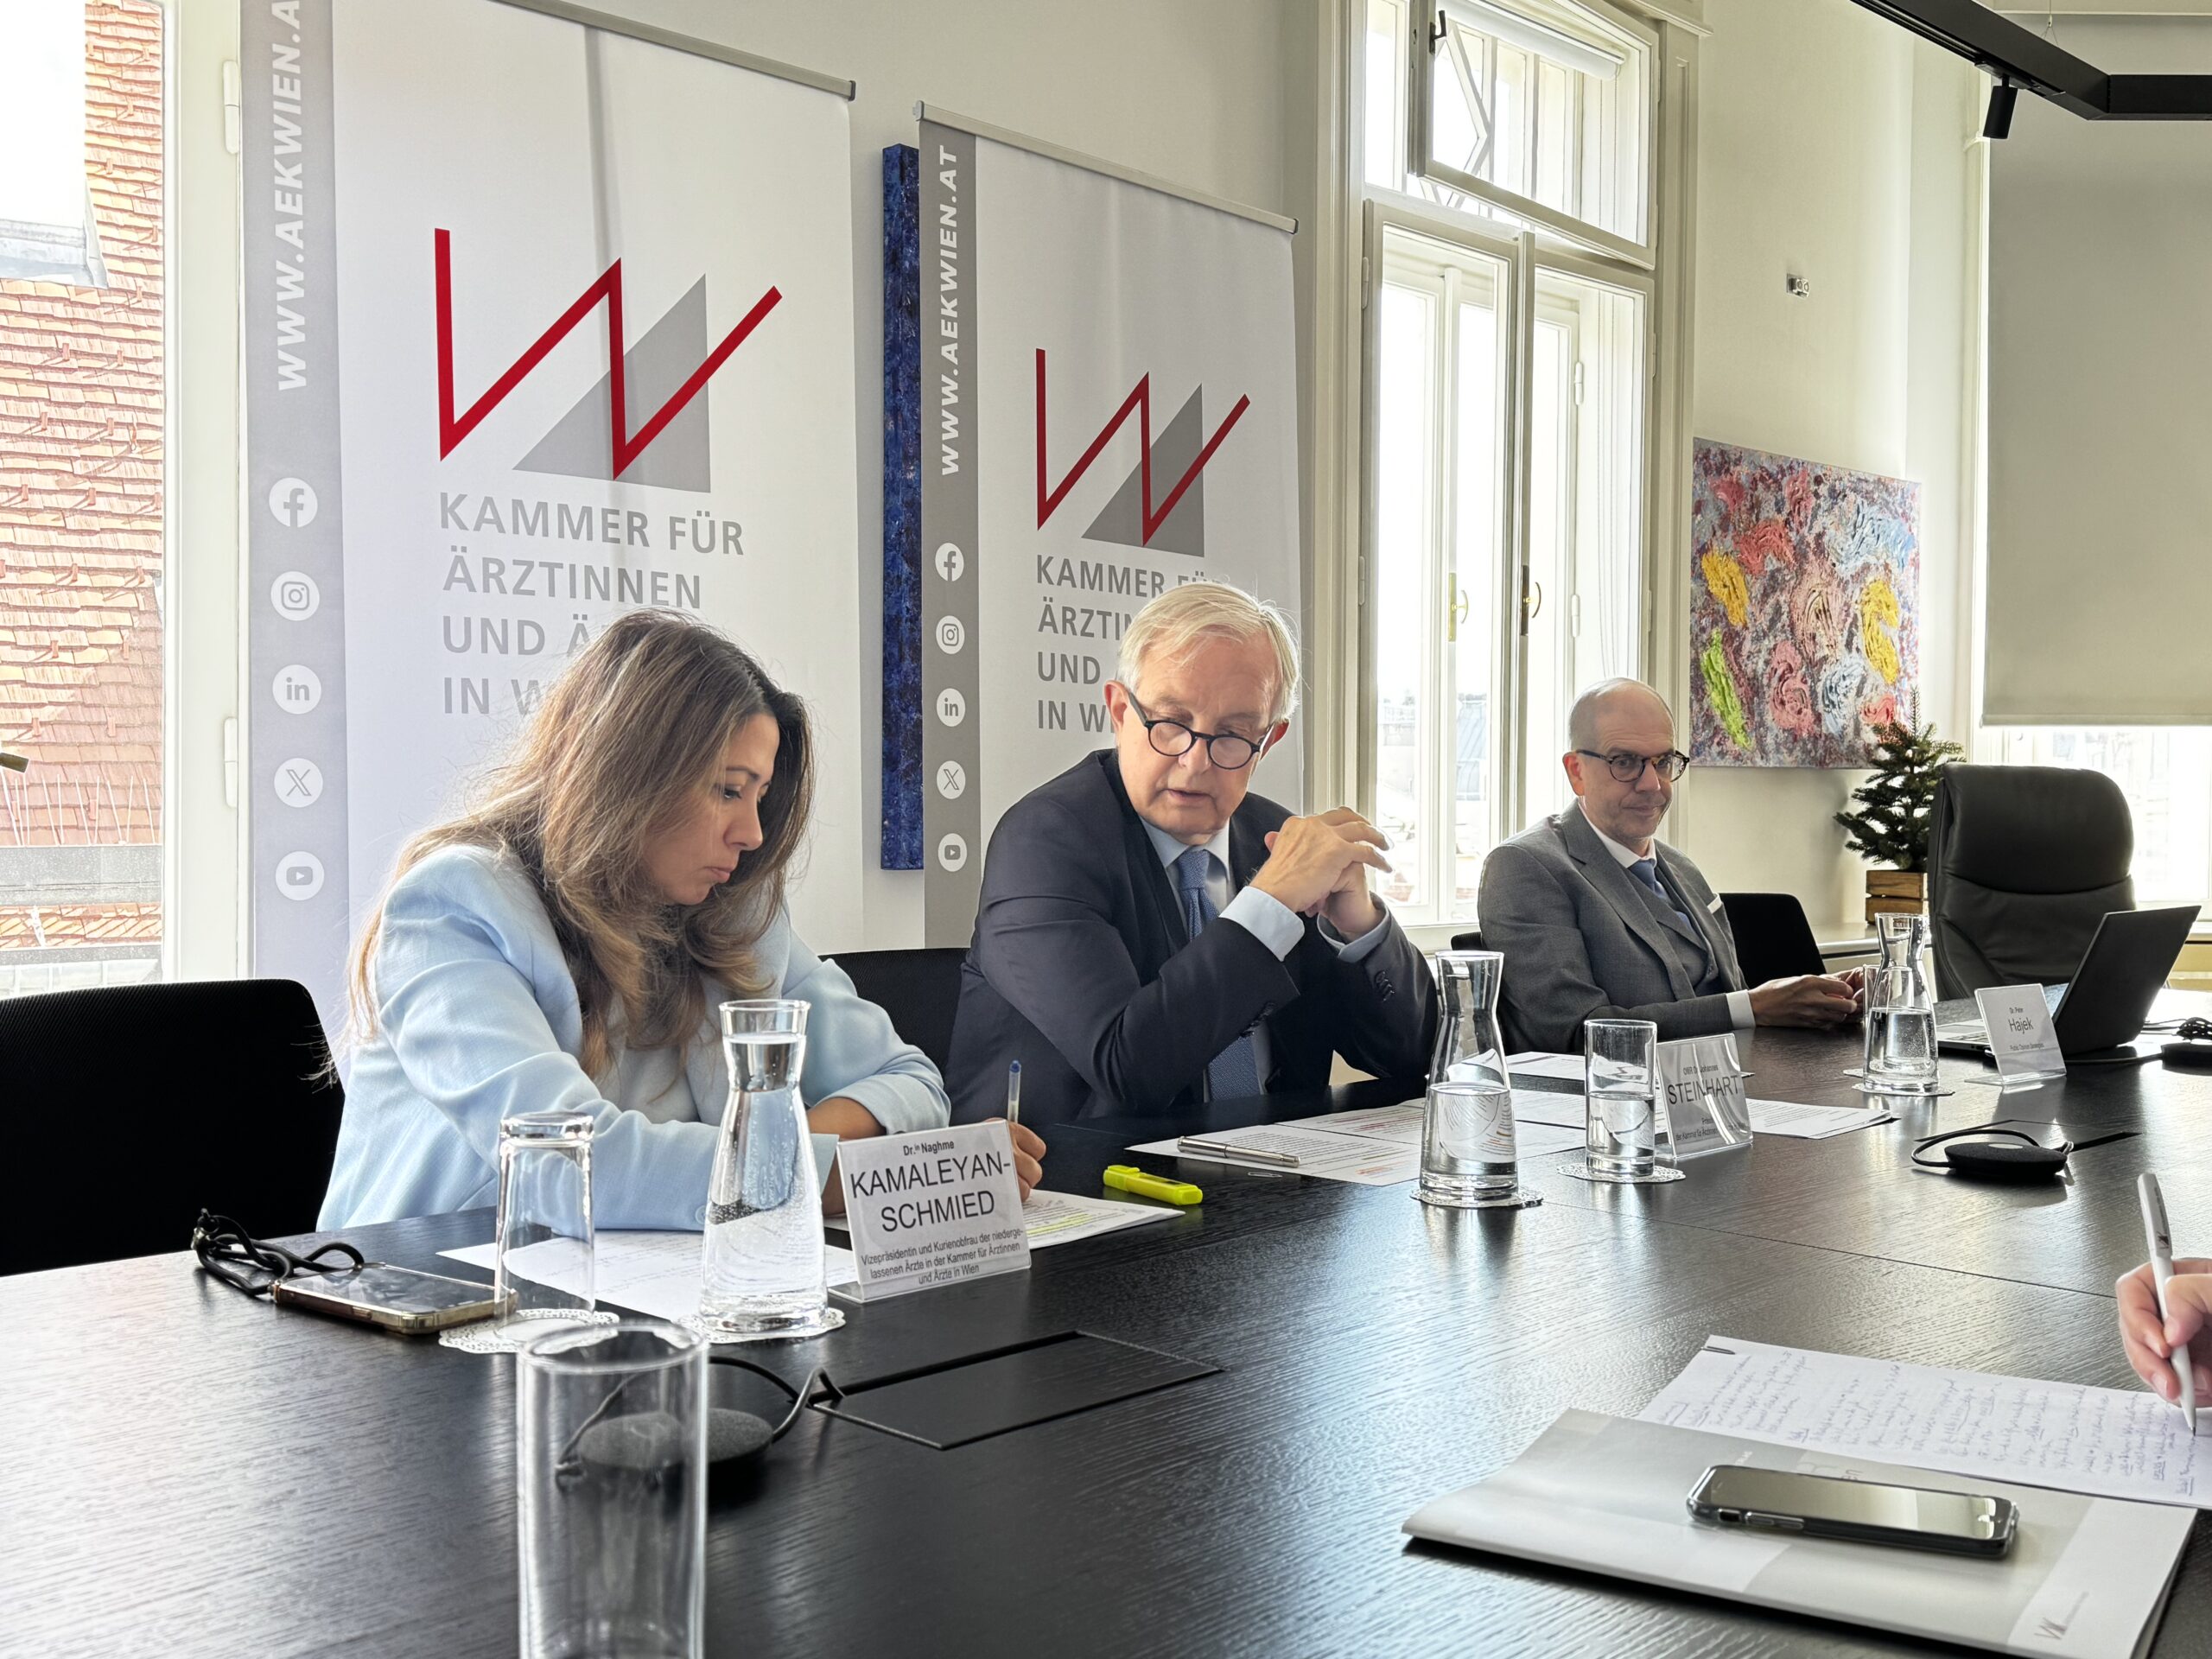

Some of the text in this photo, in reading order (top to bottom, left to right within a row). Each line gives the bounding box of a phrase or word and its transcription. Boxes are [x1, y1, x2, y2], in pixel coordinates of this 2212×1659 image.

[271, 1, 307, 391] WWW.AEKWIEN.A
[939, 145, 959, 476] WWW.AEKWIEN.AT
[440, 492, 745, 556] KAMMER FÜR
[442, 545, 702, 609] ÄRZTINNEN
[1037, 554, 1165, 598] KAMMER
[442, 615, 545, 656] UND
[1038, 652, 1101, 684] UND
[443, 677, 490, 715] IN
[1038, 700, 1066, 730] IN
[2008, 1017, 2034, 1034] Hajek
[1668, 1075, 1739, 1105] STEINHART
[921, 1140, 955, 1155] Naghme
[850, 1151, 1011, 1198] KAMALEYAN-
[880, 1190, 995, 1232] SCHMIED
[861, 1227, 1024, 1266] Vizepräsidentin und Kurienobfrau der niederge-
[870, 1265, 904, 1279] lassenen
[925, 1258, 933, 1268] in
[934, 1255, 945, 1267] der
[947, 1250, 976, 1264] Kammer
[977, 1247, 987, 1258] für
[988, 1242, 1020, 1256] Ärztinnen
[918, 1273, 932, 1285] und
[953, 1268, 960, 1278] in
[961, 1264, 980, 1277] Wien
